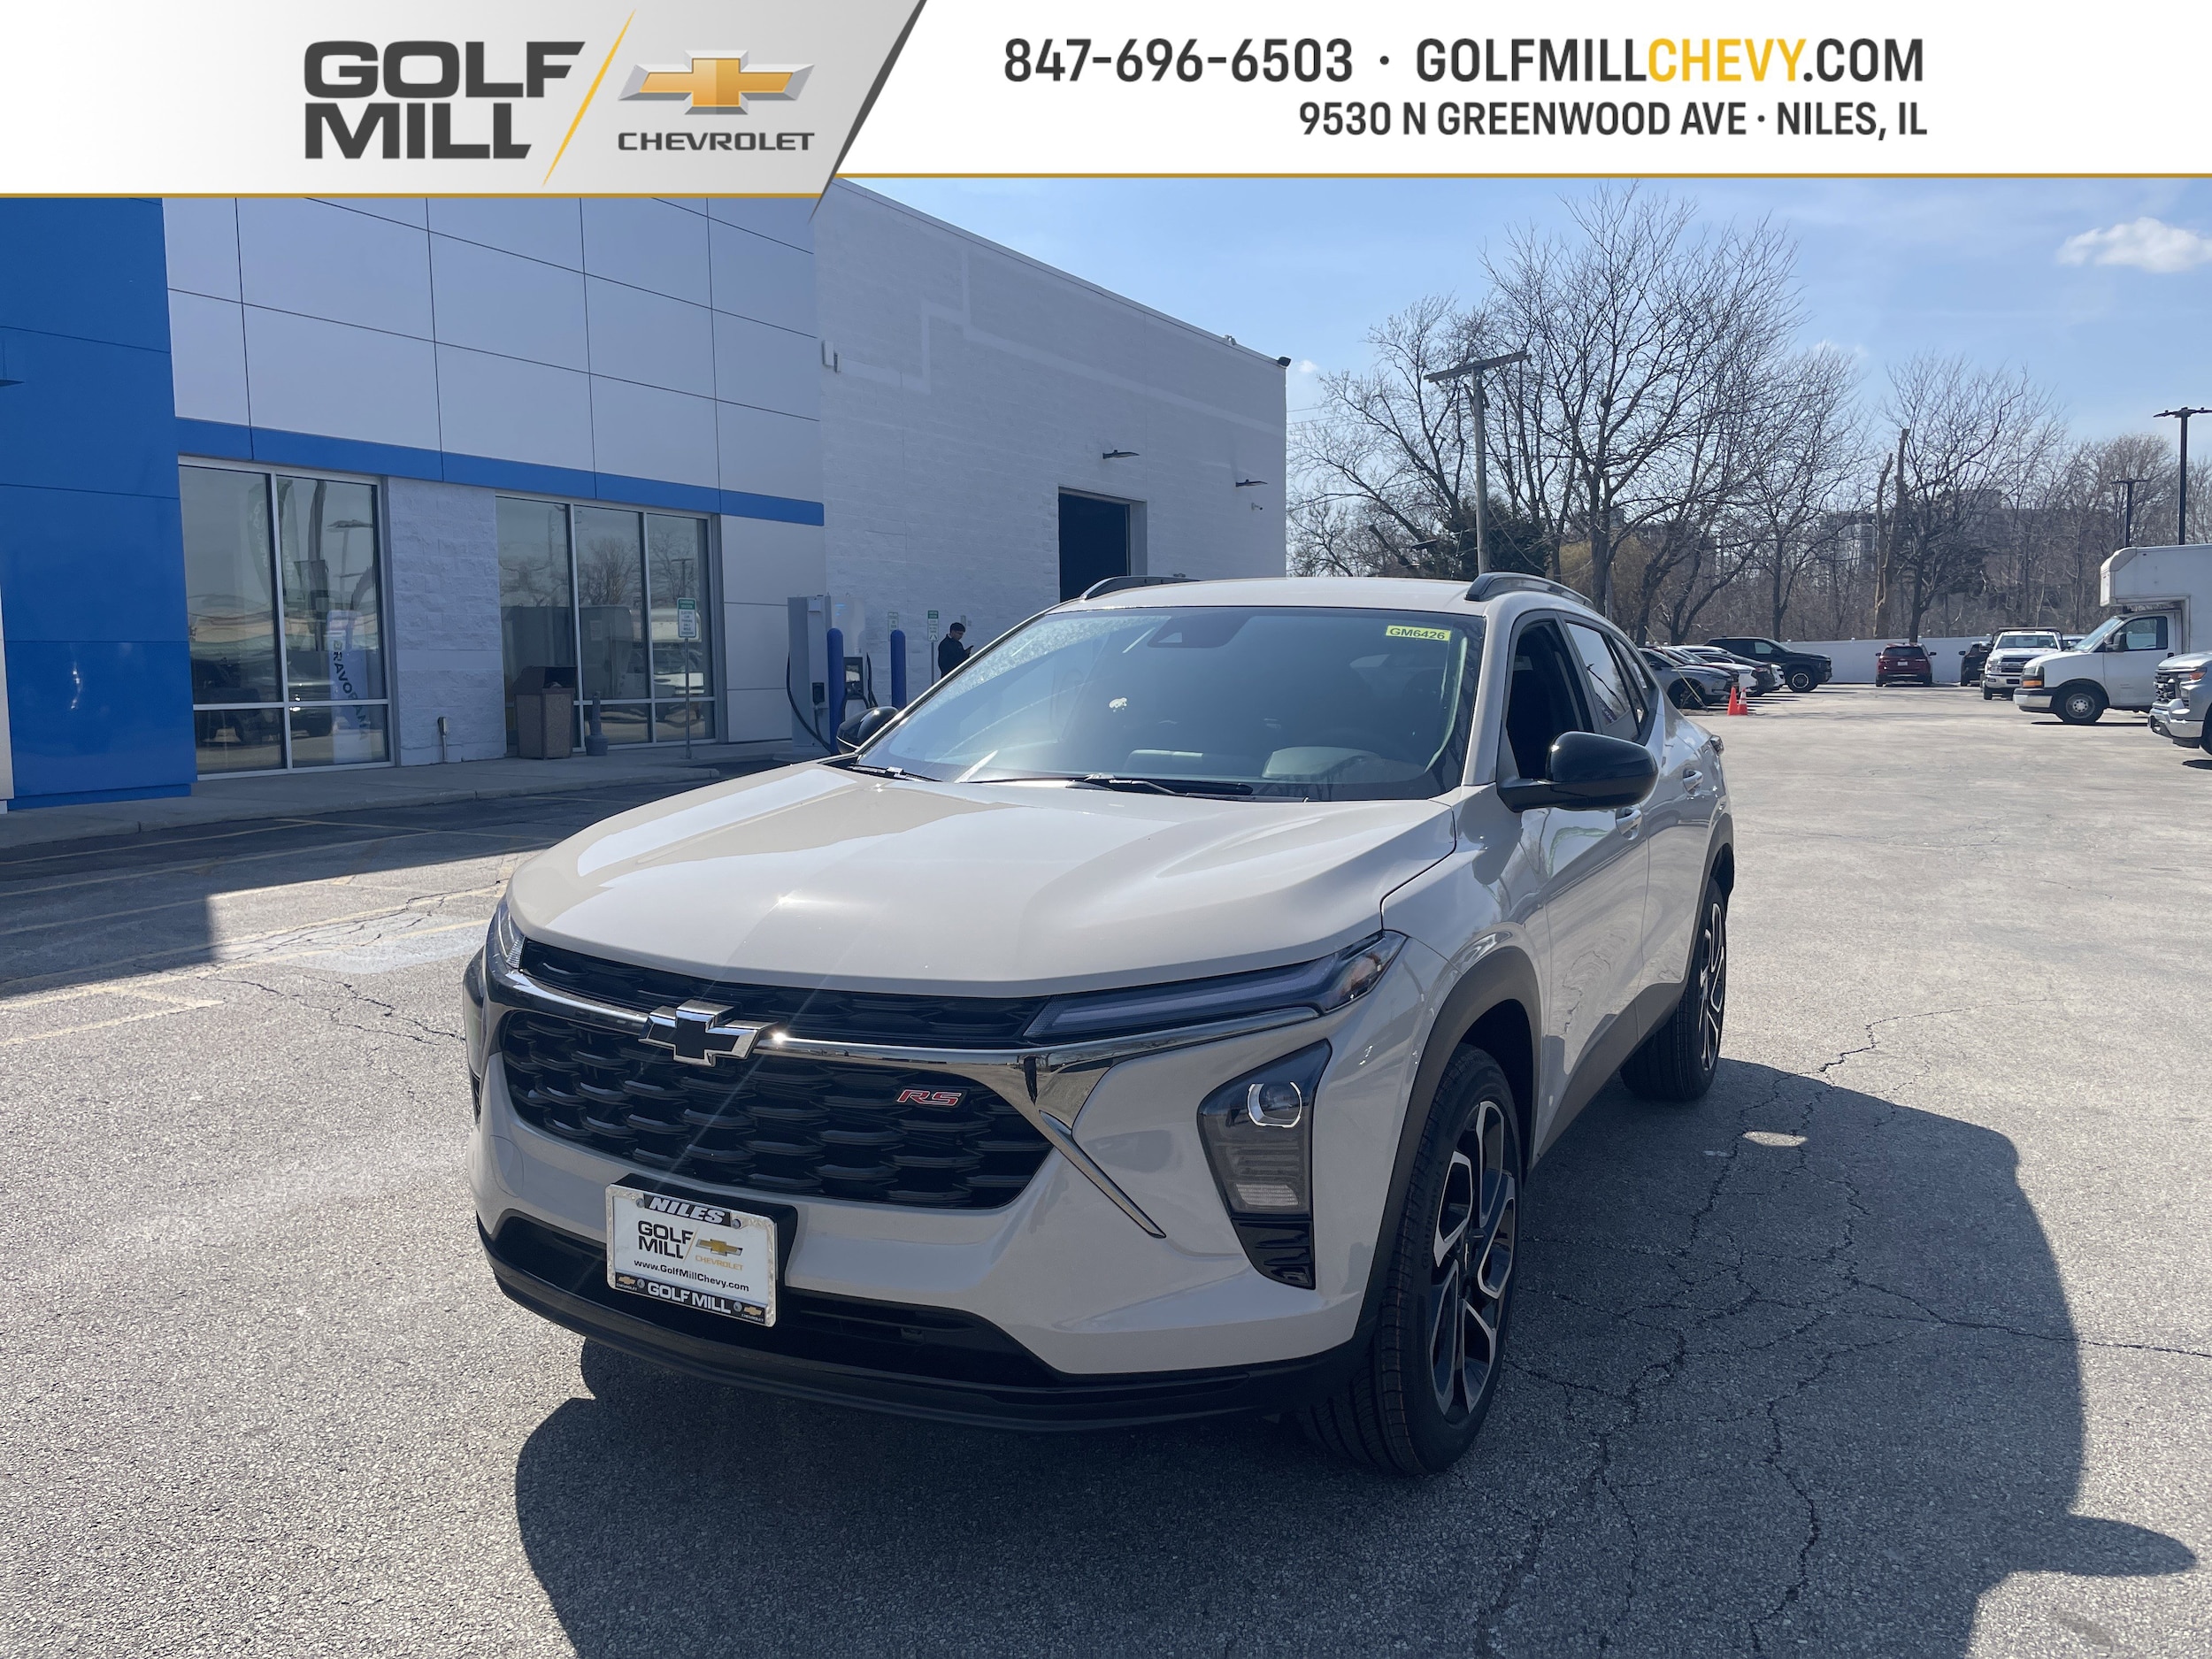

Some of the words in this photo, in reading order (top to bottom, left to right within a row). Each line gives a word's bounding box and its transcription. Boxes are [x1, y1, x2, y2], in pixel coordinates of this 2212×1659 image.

[1389, 627, 1445, 639] GM6426
[896, 1089, 962, 1106] RS
[649, 1196, 726, 1225] NILES
[637, 1220, 694, 1245] GOLF
[638, 1236, 684, 1260] MILL
[695, 1255, 744, 1271] CHEVROLET
[634, 1259, 749, 1293] www.GolfMillChevy.com
[647, 1282, 691, 1304] GOLF
[691, 1293, 732, 1314] MILL
